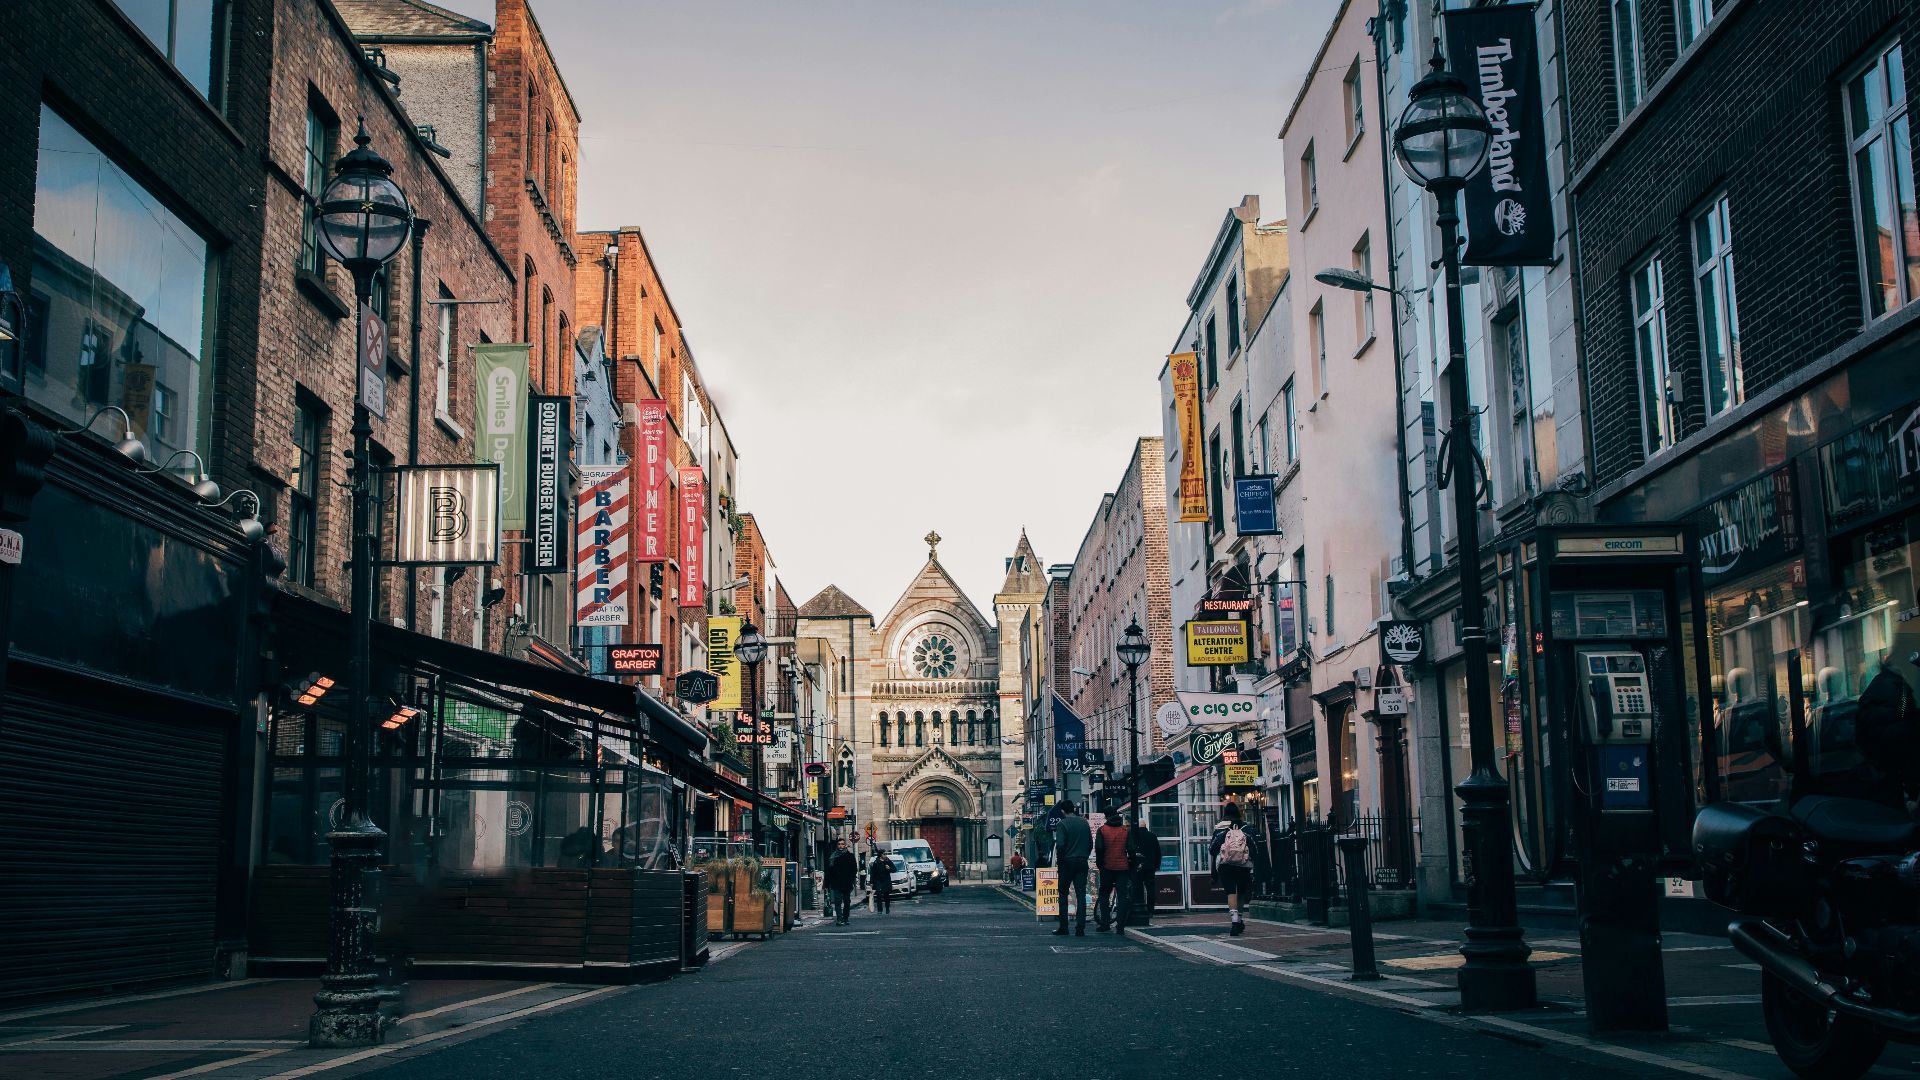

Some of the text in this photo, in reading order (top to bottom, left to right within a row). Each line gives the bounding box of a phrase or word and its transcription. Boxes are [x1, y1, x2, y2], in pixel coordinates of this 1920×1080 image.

[1476, 37, 1522, 192] Timberland
[495, 374, 510, 428] Smiles
[538, 402, 556, 567] GOURMET BURGER KITCHEN
[646, 444, 658, 556] DINER
[429, 486, 467, 542] B
[594, 490, 613, 604] BARBER
[686, 506, 697, 602] DINER
[1204, 601, 1249, 610] RESTAURANT
[1197, 625, 1239, 634] TAILORING
[1193, 637, 1244, 646] ALTERATIONS
[611, 649, 660, 659] GRAFTON
[1204, 647, 1233, 655] CENTRE
[615, 660, 656, 669] BARBER
[678, 677, 716, 698] EAT
[1190, 701, 1253, 717] e cig co
[1387, 704, 1399, 712] 30
[1056, 742, 1084, 750] MAGEE
[1192, 731, 1237, 764] Cave
[1064, 758, 1081, 772] 22
[1043, 897, 1060, 905] CENTR
